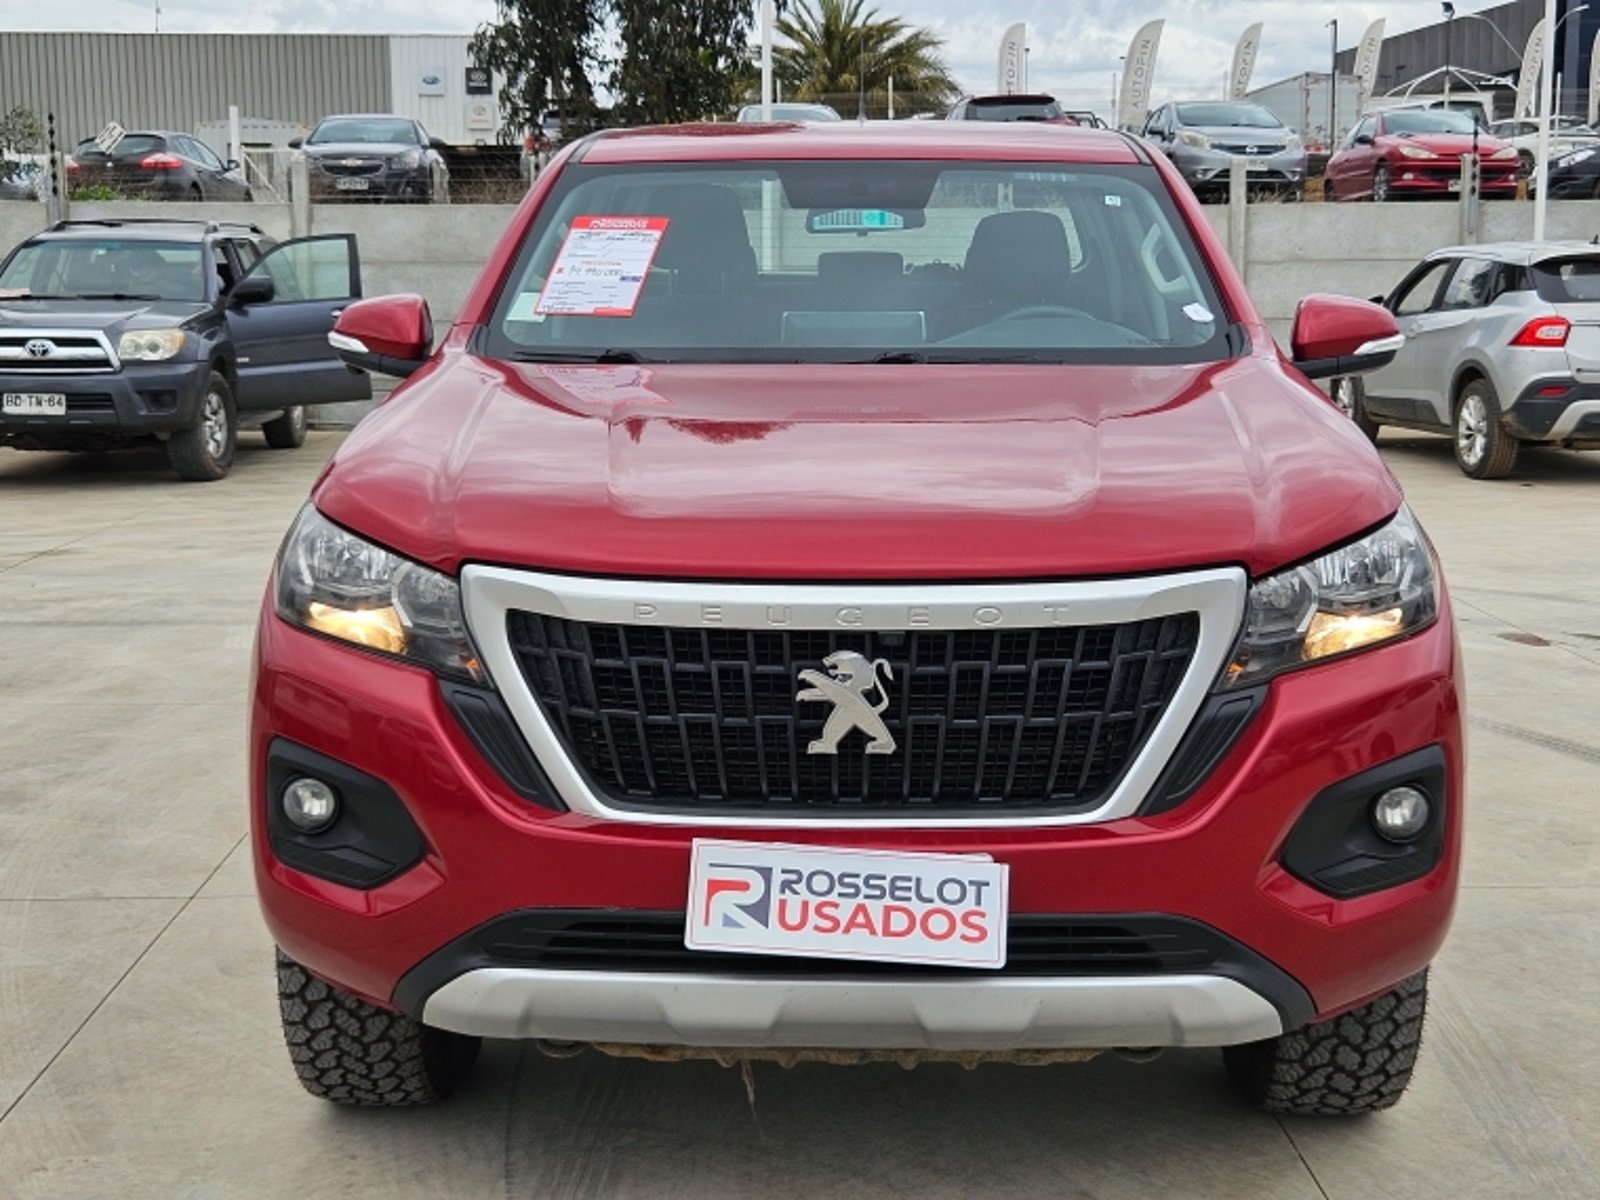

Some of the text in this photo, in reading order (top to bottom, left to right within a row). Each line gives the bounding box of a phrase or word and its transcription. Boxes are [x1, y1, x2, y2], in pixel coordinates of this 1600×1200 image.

[1131, 39, 1150, 109] AUTOFIN
[633, 602, 1070, 626] PEUGEOT
[778, 868, 991, 907] ROSSELOT
[777, 898, 989, 944] USADOS
